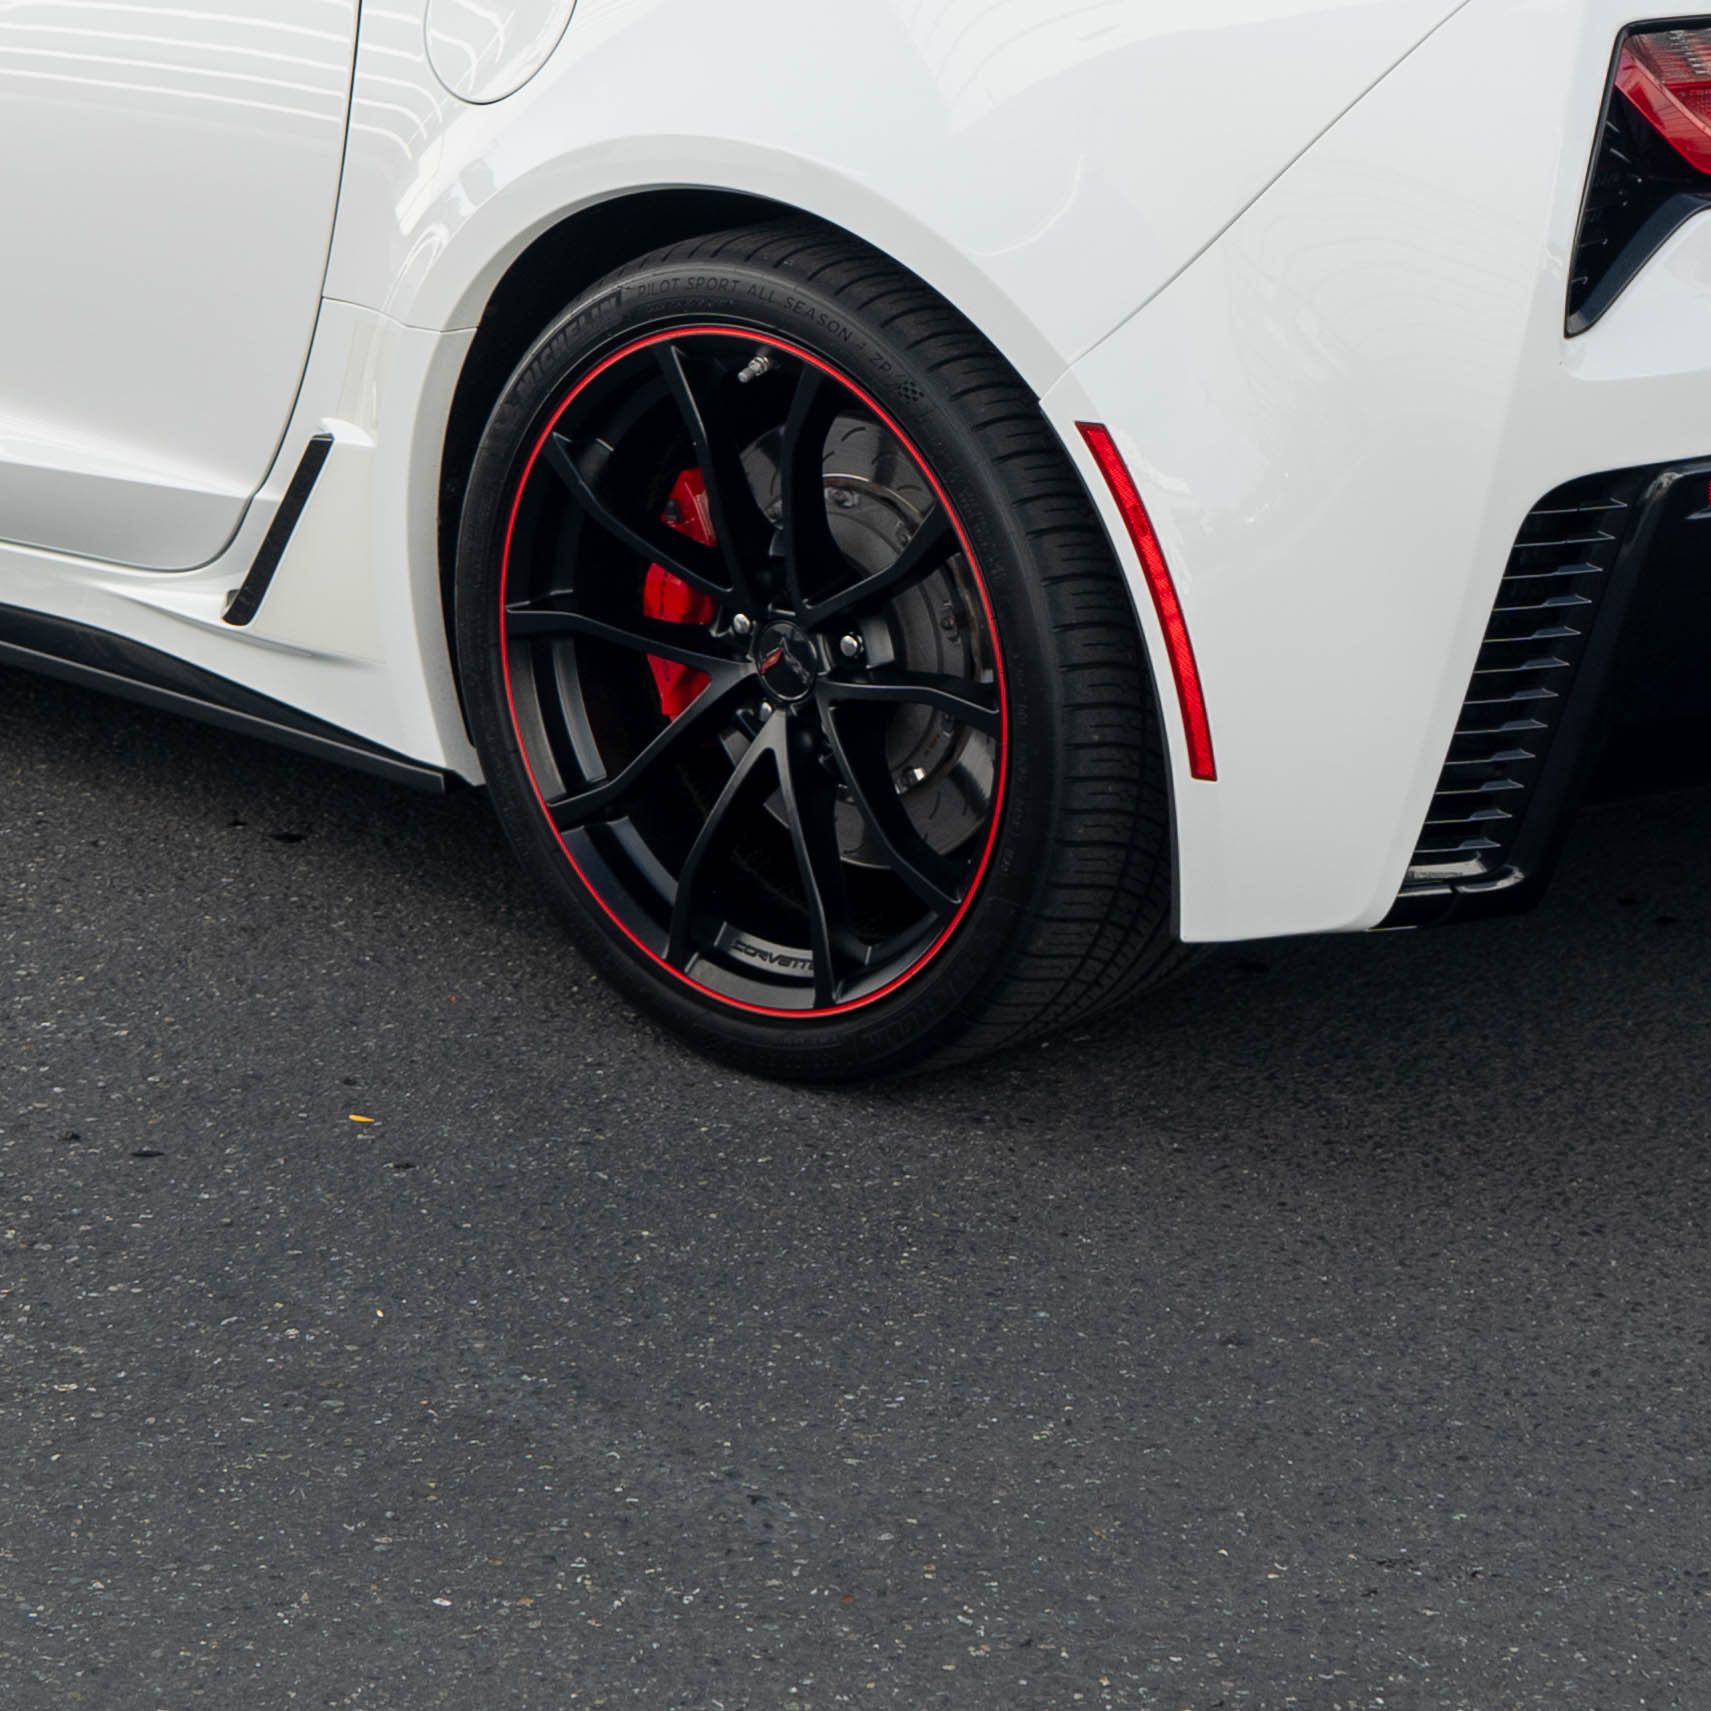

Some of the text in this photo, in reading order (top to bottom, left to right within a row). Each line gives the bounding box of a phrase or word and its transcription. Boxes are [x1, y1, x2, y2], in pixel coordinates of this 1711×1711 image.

[639, 277, 681, 297] PILOT
[688, 276, 740, 293] SPORT
[747, 284, 776, 304] ALL
[784, 296, 853, 342] SEASON
